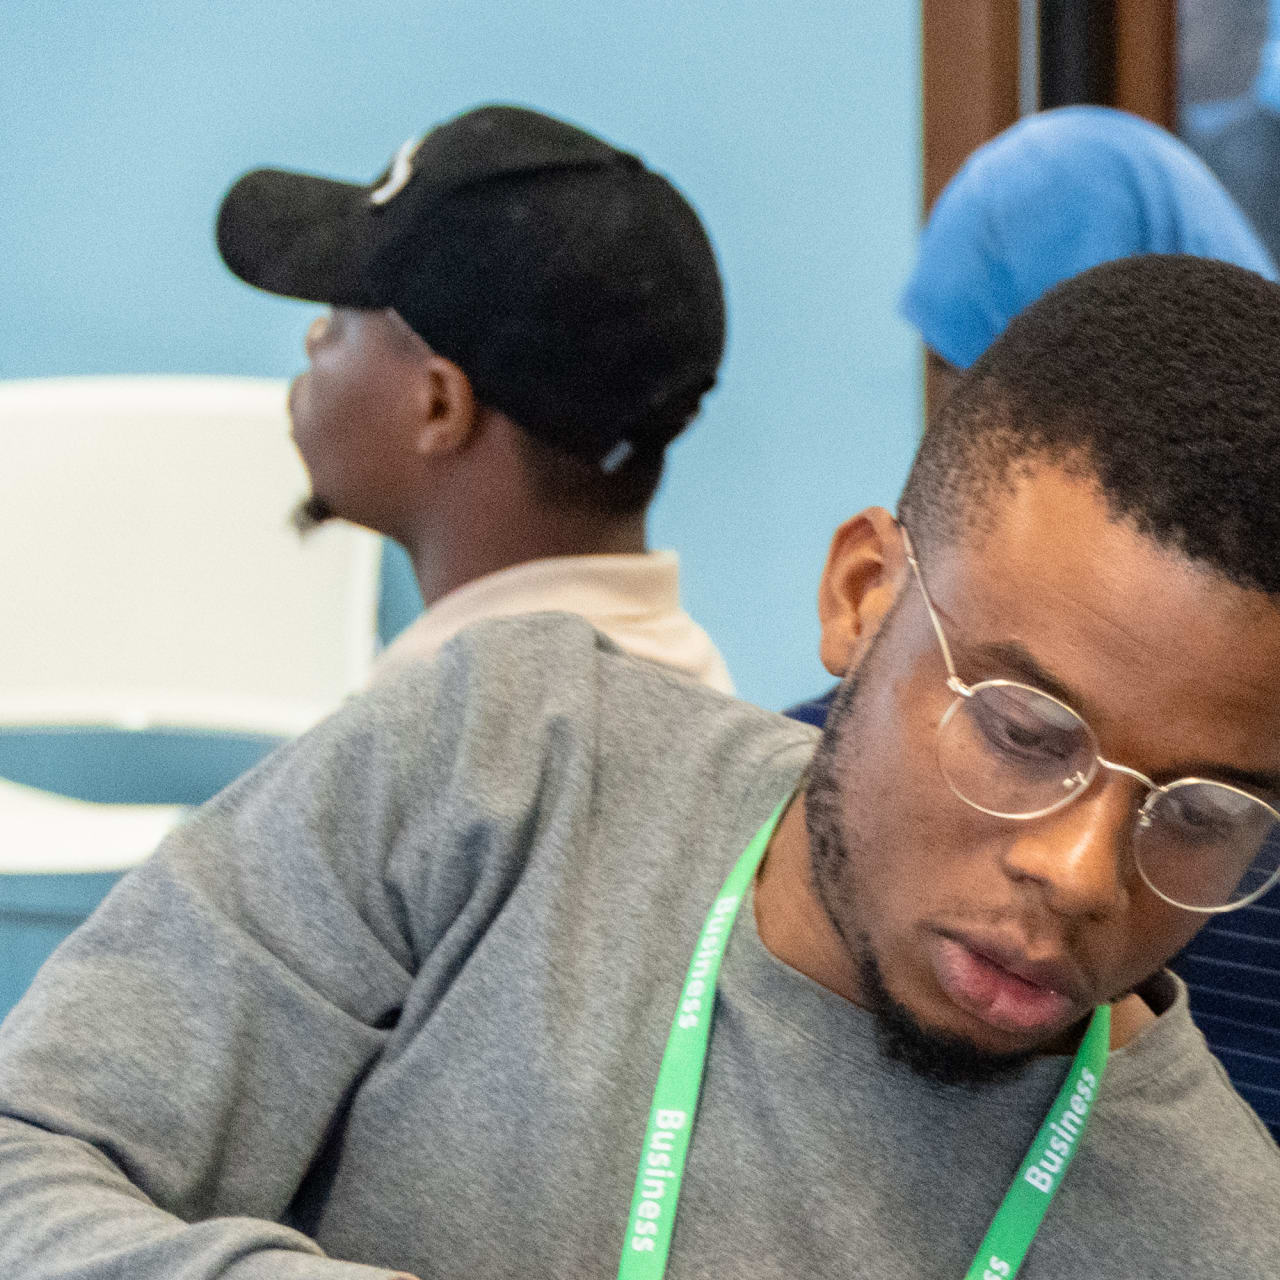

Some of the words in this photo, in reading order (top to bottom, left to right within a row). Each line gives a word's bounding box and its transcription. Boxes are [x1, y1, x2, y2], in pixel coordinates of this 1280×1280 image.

[678, 895, 738, 1029] Business
[631, 1109, 687, 1253] Business
[1023, 1066, 1097, 1194] Business
